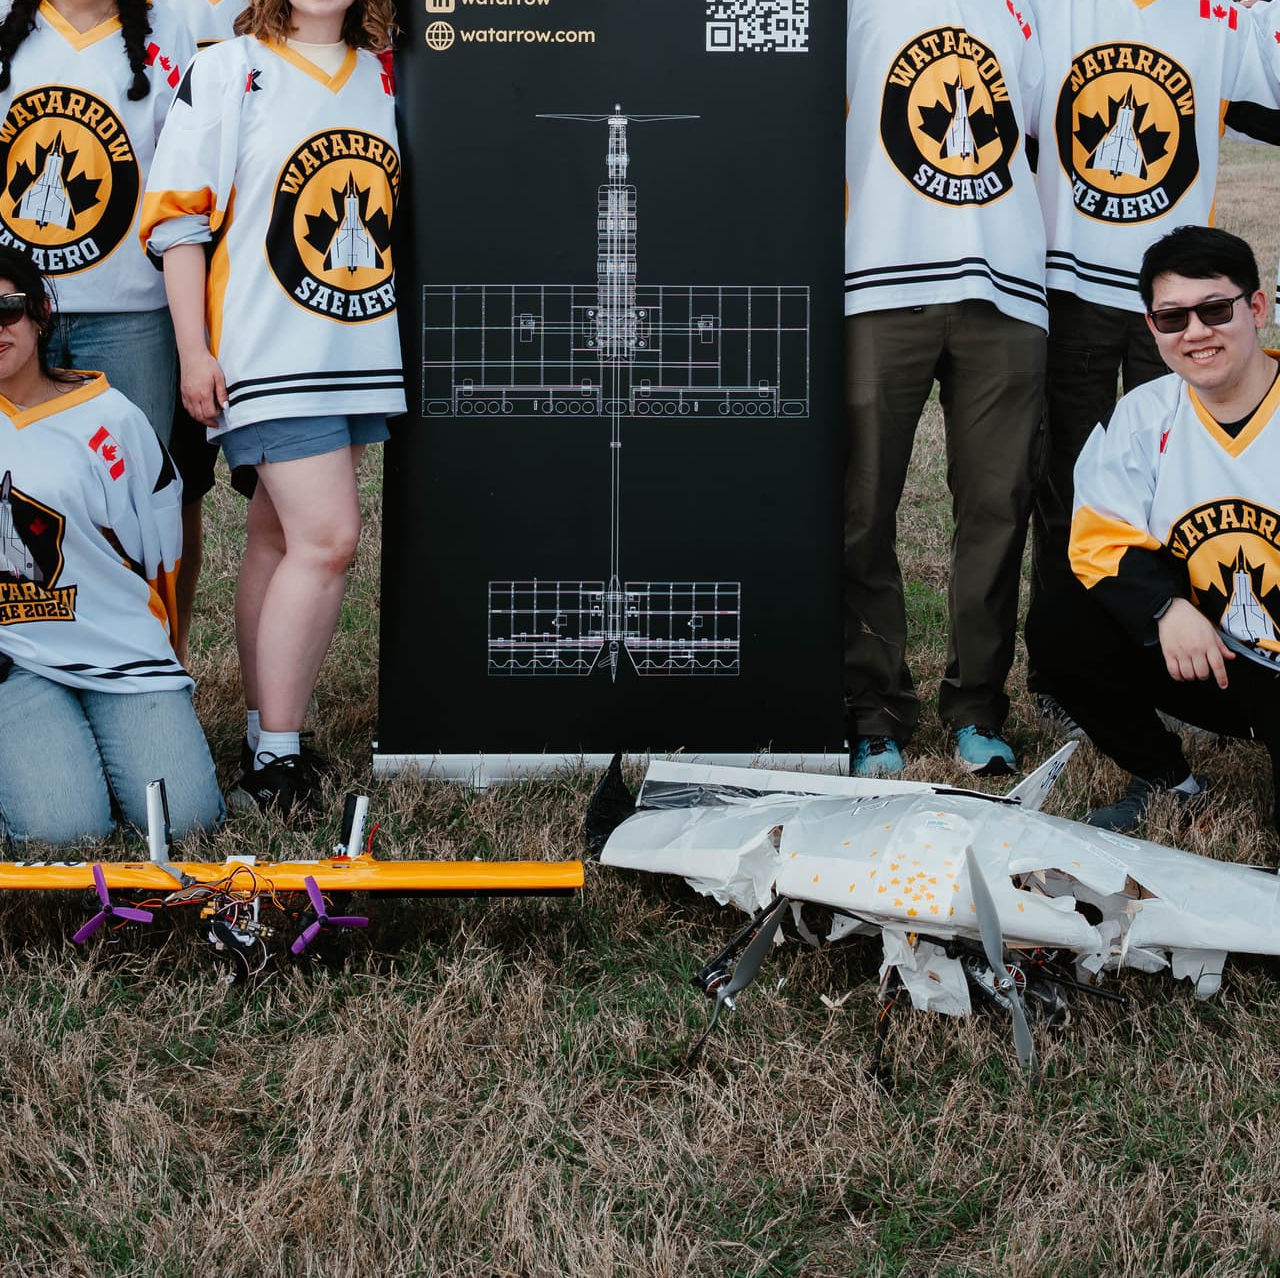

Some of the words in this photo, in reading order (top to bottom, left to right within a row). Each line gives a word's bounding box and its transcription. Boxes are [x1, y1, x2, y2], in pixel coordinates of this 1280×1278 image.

[460, 28, 596, 43] watarrow.com
[913, 164, 960, 201] SAE
[1072, 177, 1101, 212] AE
[1102, 186, 1169, 219] AERO
[32, 237, 100, 270] AERO
[295, 276, 346, 315] SAE
[347, 278, 398, 317] AER
[24, 604, 70, 617] 2025
